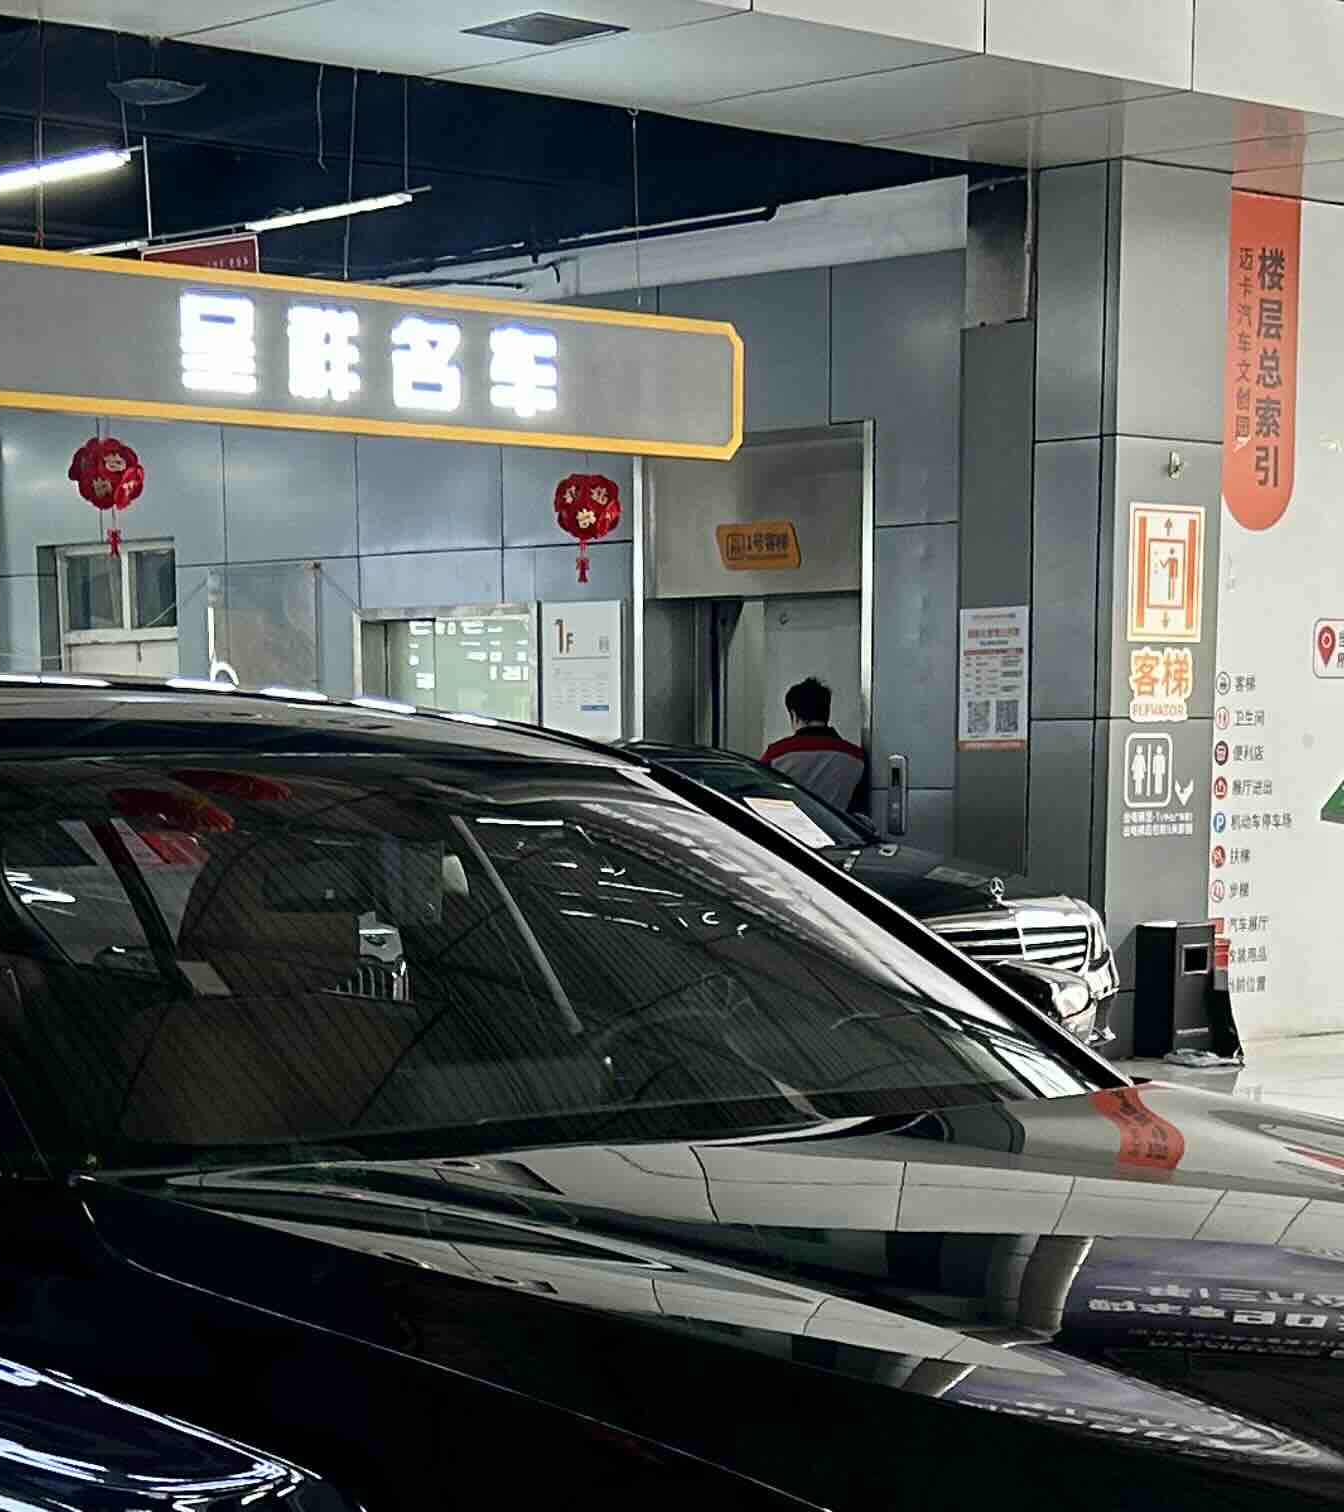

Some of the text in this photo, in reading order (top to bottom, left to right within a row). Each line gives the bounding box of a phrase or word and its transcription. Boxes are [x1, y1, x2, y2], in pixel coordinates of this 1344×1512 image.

[1256, 246, 1284, 488] 楼层总索引
[1135, 654, 1191, 698] 客梯
[1234, 710, 1265, 726] 卫生间
[1233, 745, 1264, 761] 便利店
[1231, 813, 1293, 830] 机动车停车场
